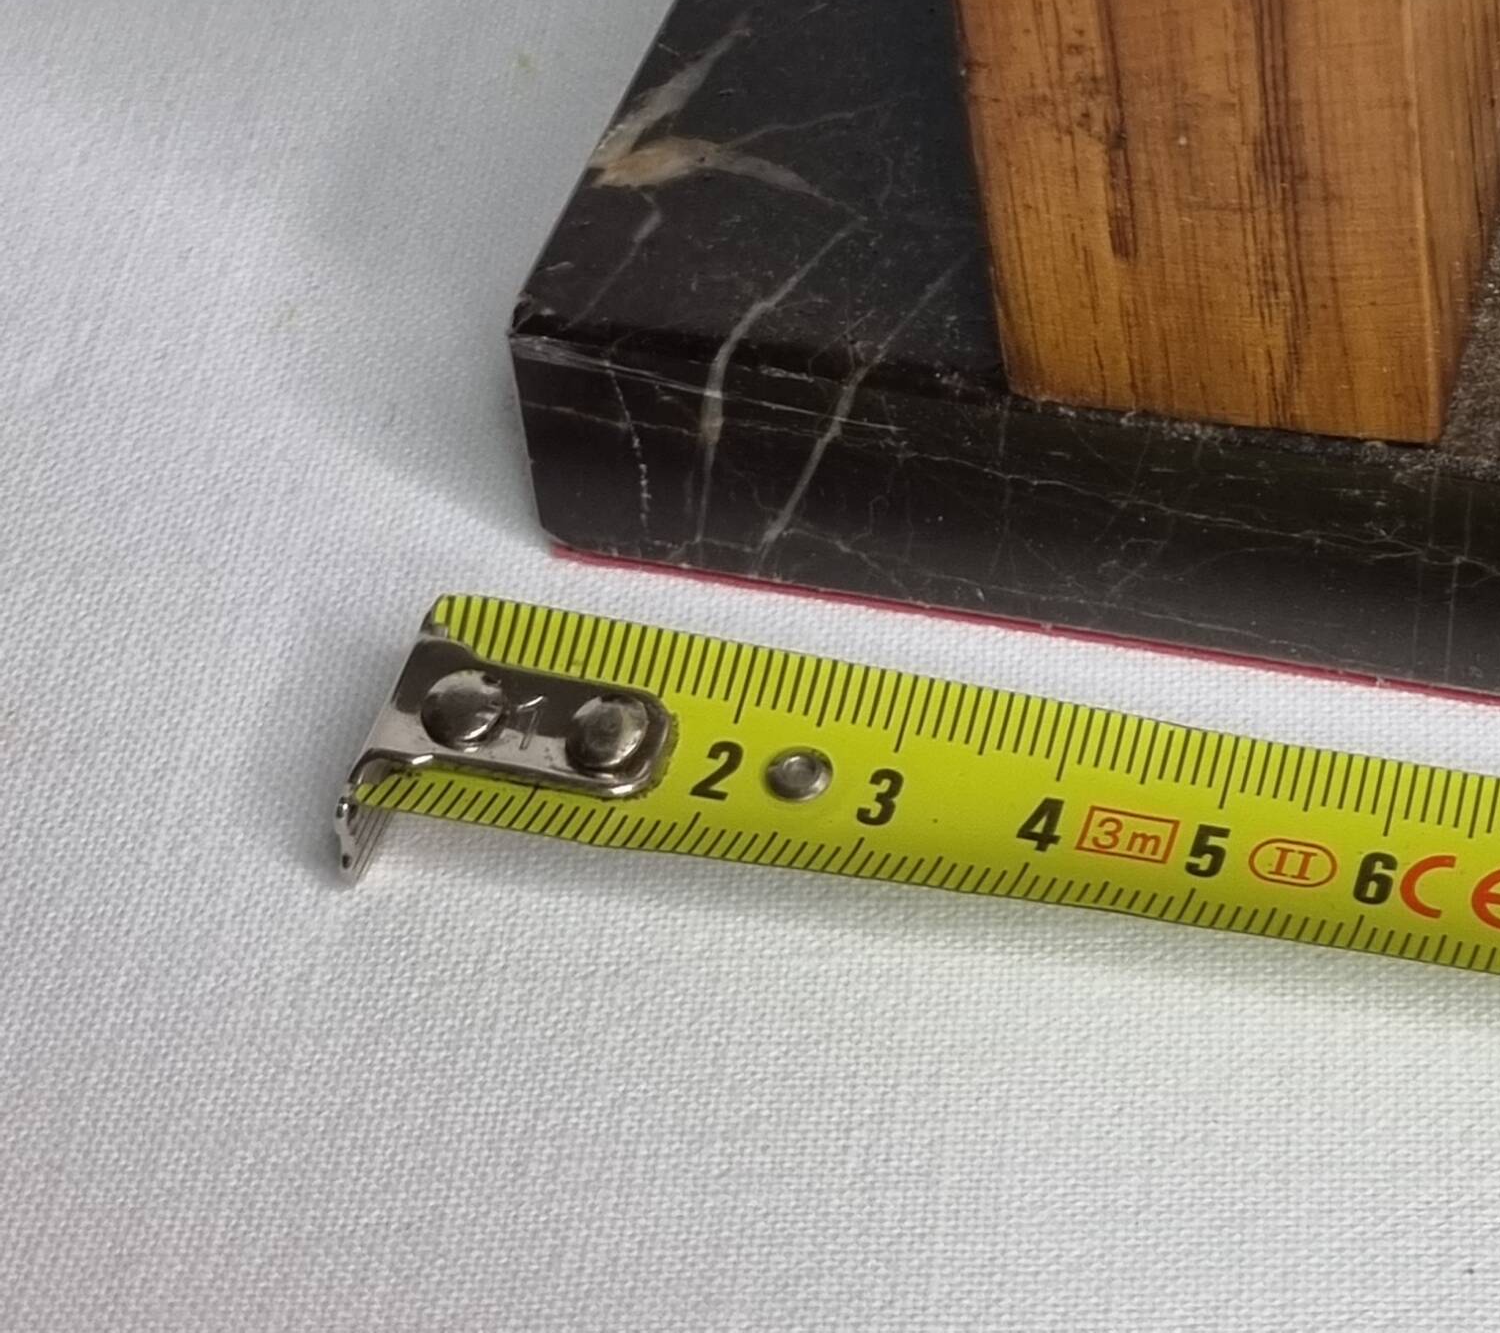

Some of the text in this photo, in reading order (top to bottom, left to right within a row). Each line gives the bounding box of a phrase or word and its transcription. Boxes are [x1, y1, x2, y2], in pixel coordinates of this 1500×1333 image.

[690, 741, 744, 801] 2
[856, 768, 904, 826] 3
[1017, 797, 1065, 851] 4
[1185, 823, 1232, 877] 5
[1352, 851, 1398, 906] 6
